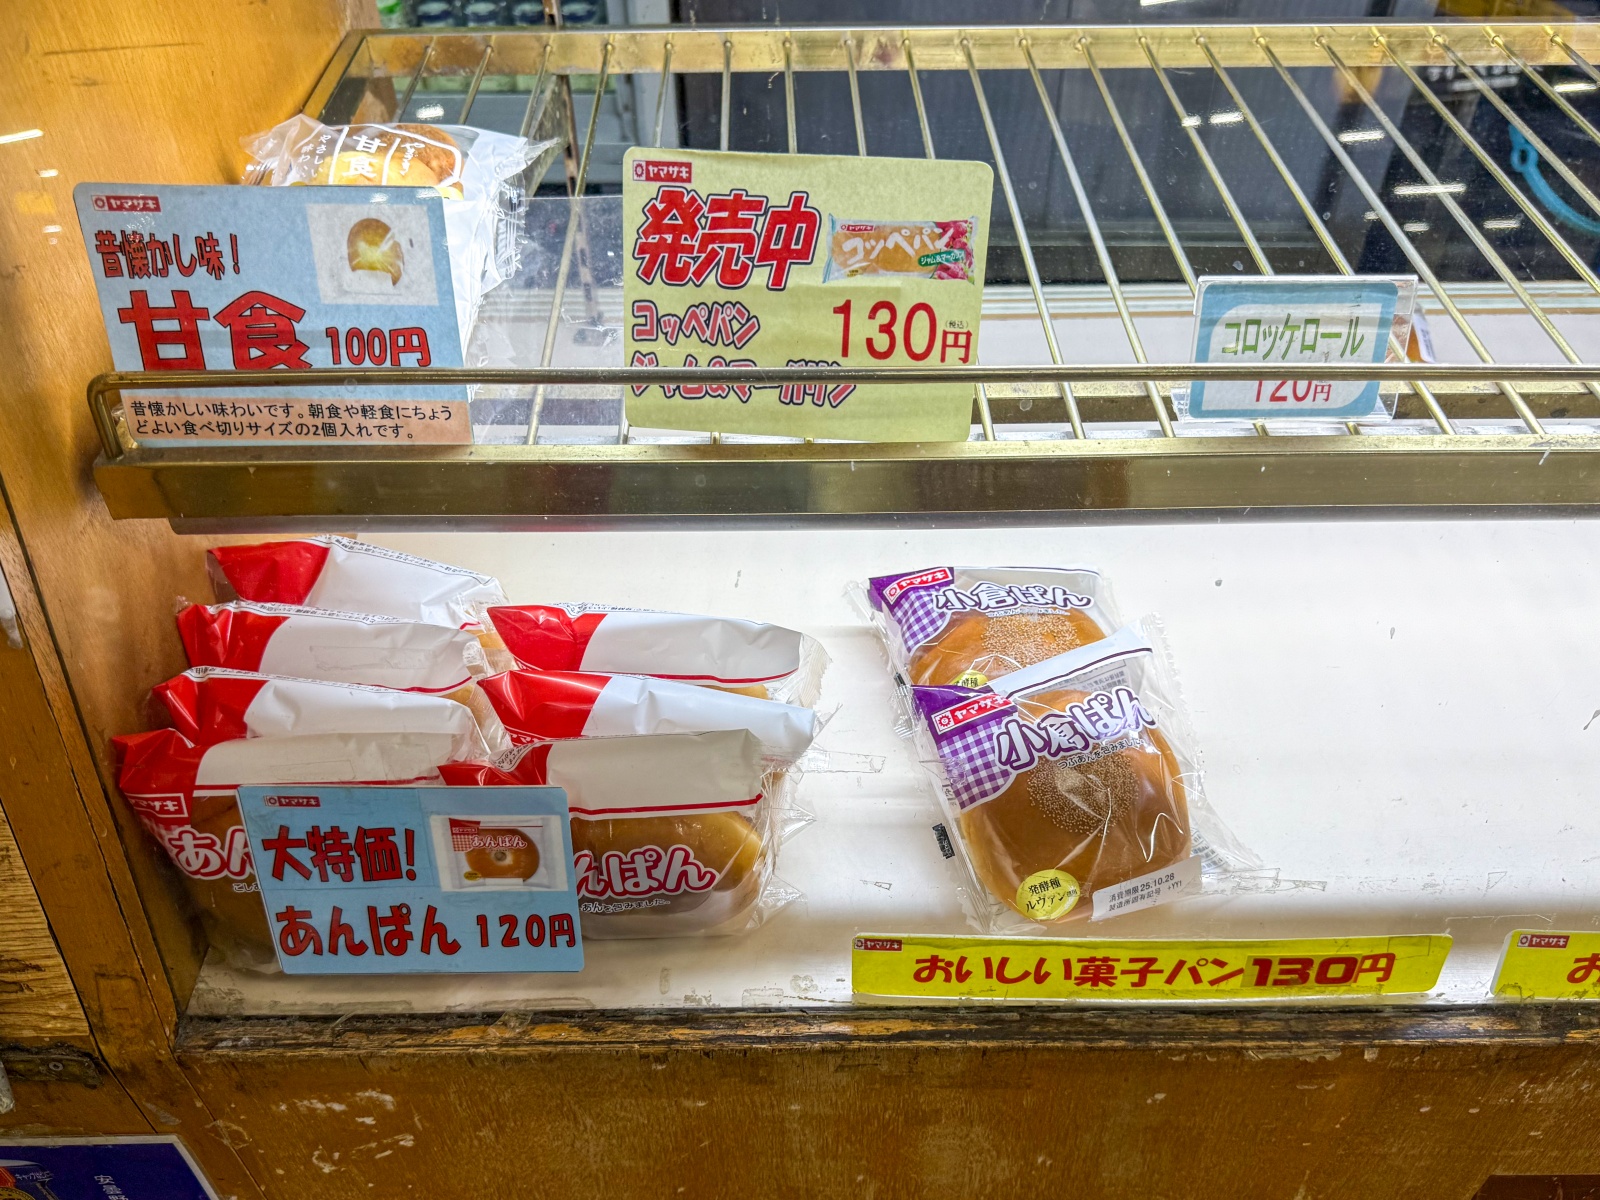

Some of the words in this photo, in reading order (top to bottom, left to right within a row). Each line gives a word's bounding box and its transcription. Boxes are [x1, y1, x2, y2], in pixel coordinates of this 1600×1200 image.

[342, 134, 387, 178] 甘食
[647, 163, 690, 180] ヤマザキ
[95, 230, 241, 280] 昔懐かし味!
[633, 186, 821, 291] 発売中
[842, 228, 954, 265] コッペパン
[118, 290, 312, 370] 甘食
[326, 326, 431, 367] 100円
[631, 299, 761, 348] コッペパン
[832, 299, 973, 363] 130円
[1221, 313, 1365, 360] コロッケロール
[1255, 380, 1332, 403] 120円
[130, 401, 454, 422] 昔懐かしい味わいです。朝食や軽食にちょう
[135, 420, 414, 439] どよい食べ切りサイズの2個入れです。
[898, 570, 946, 589] ヤマザキ
[932, 581, 1094, 611] 小倉ぱん
[954, 695, 1011, 721] ヤマザキ
[995, 687, 1158, 771] 小倉ぱん
[1057, 737, 1145, 770] つぶあんを包みました。
[262, 825, 417, 883] 大特価!
[470, 834, 528, 850] あんぱん
[1028, 876, 1062, 896] 発酵種
[275, 901, 461, 956] あんぱん
[476, 913, 577, 948] 120円
[913, 952, 1396, 988] おいしい菓子パン130円
